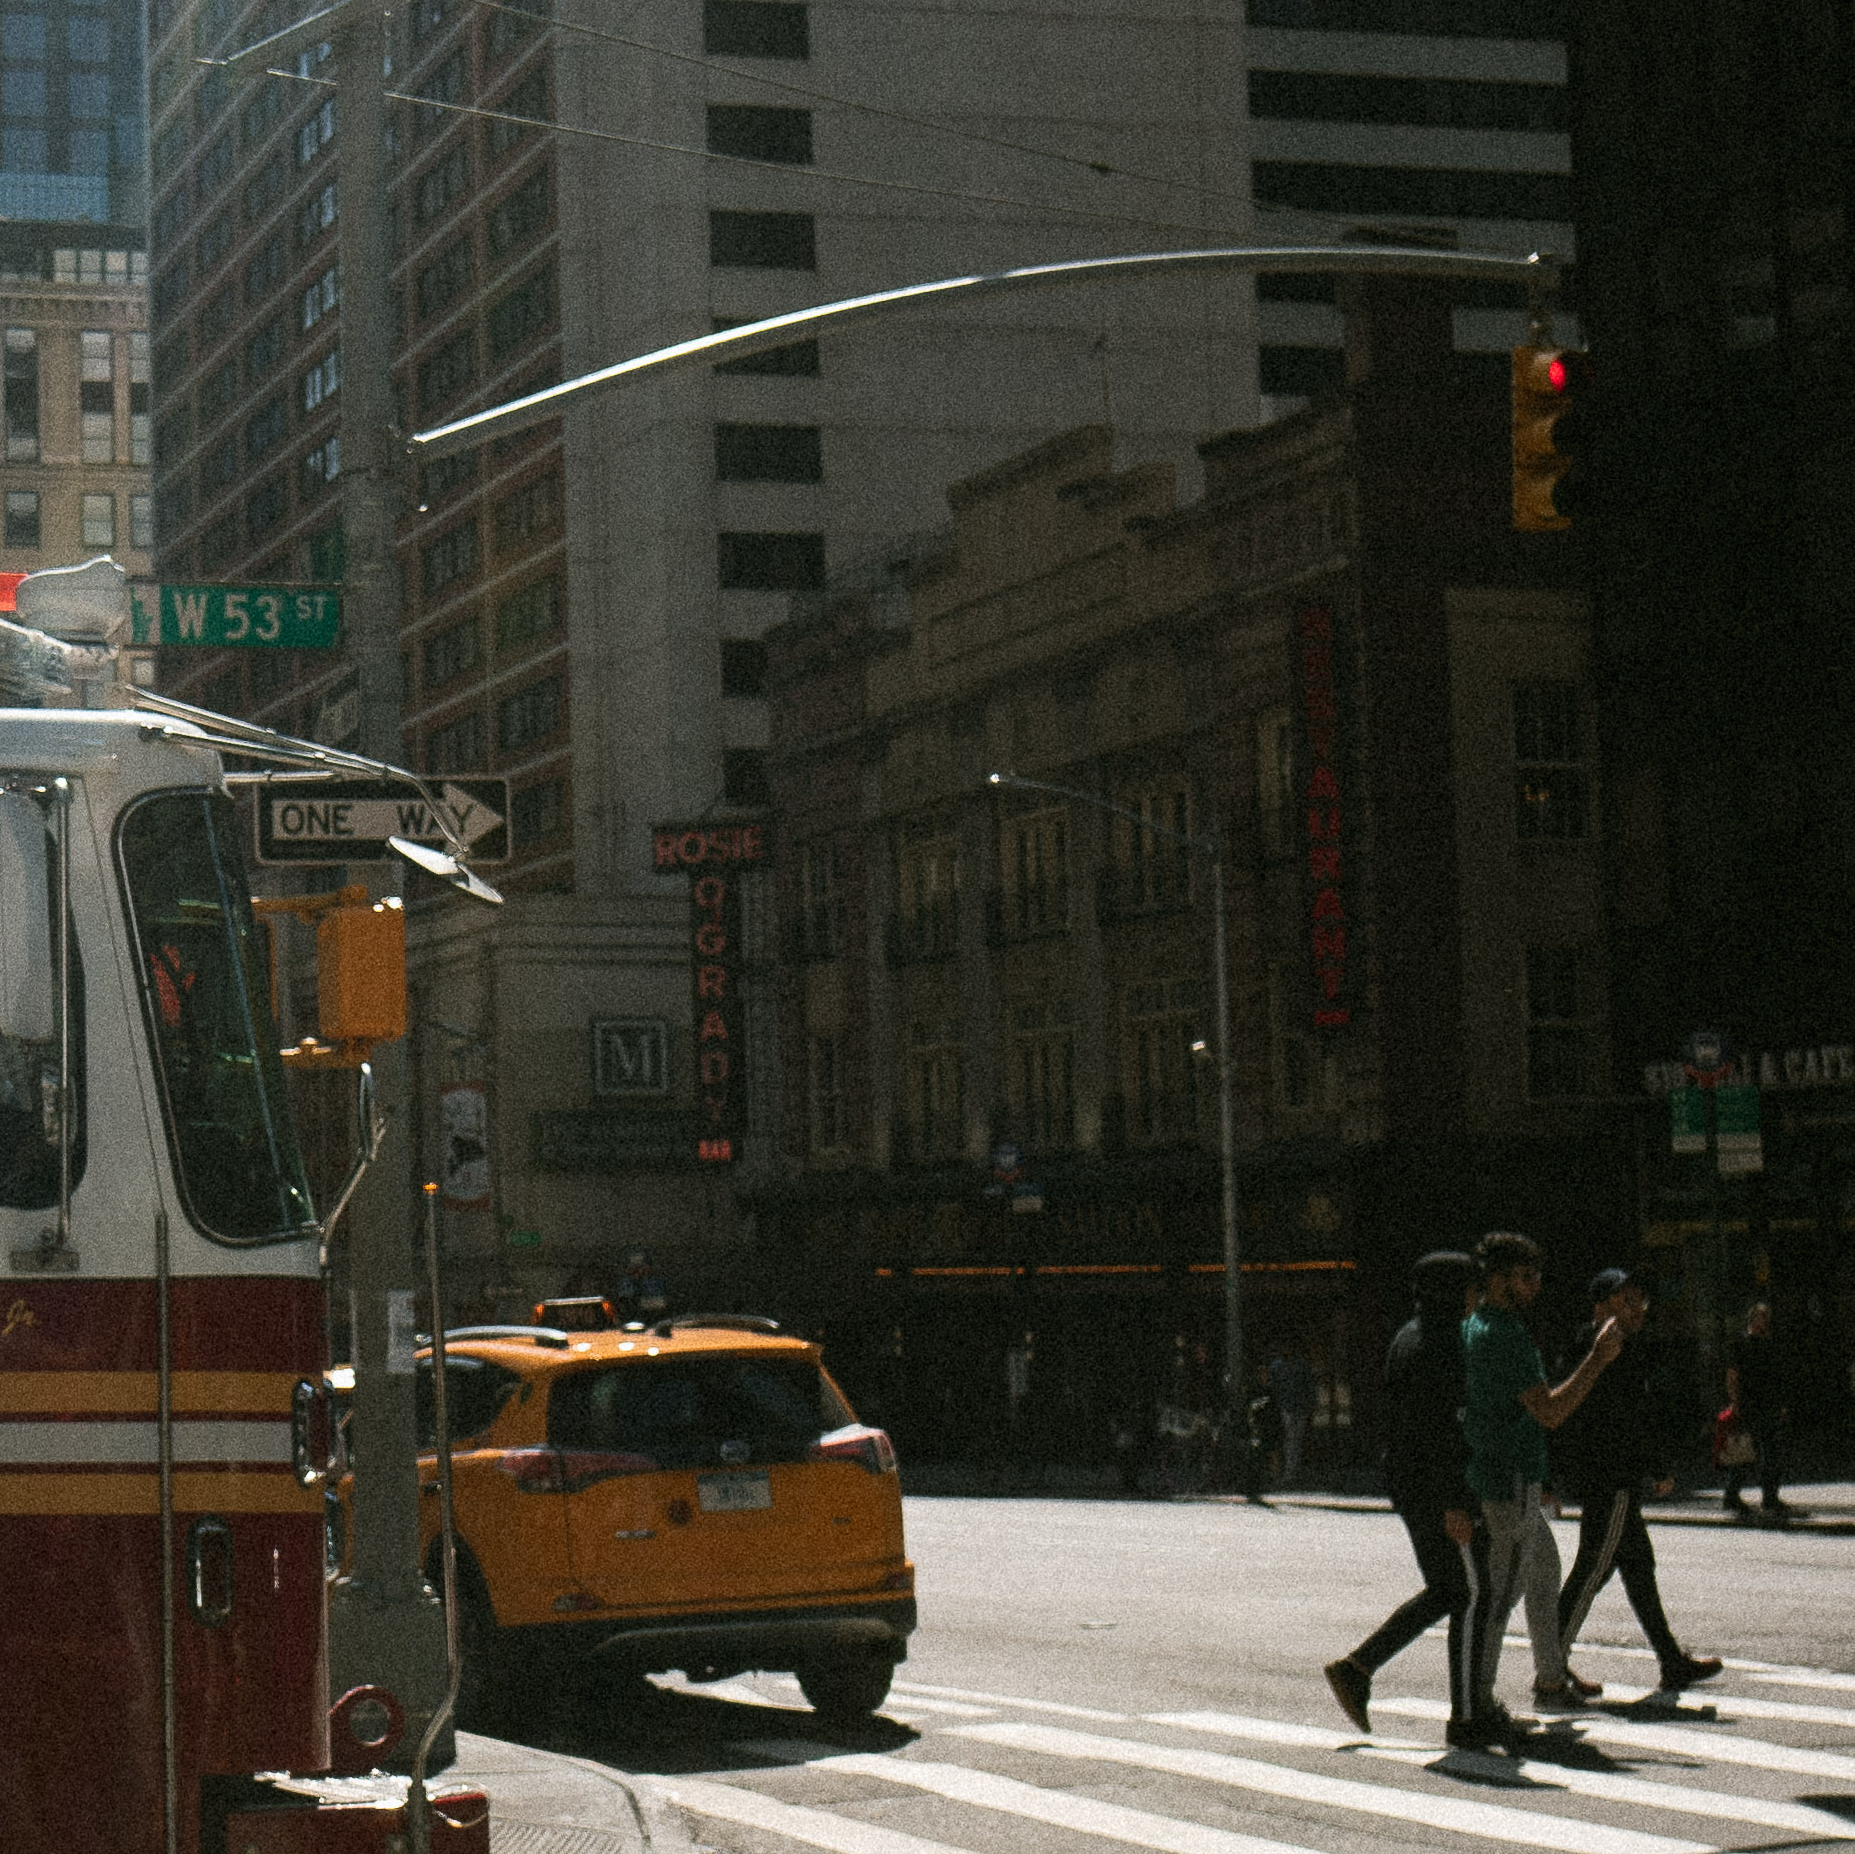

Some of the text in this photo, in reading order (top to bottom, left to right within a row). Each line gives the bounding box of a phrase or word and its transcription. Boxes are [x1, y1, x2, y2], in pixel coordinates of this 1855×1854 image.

[172, 592, 328, 641] W 53 ST
[280, 803, 474, 836] ONE WAY
[655, 825, 763, 867] ROSIE
[608, 1033, 653, 1082] M
[697, 1139, 733, 1162] BAR
